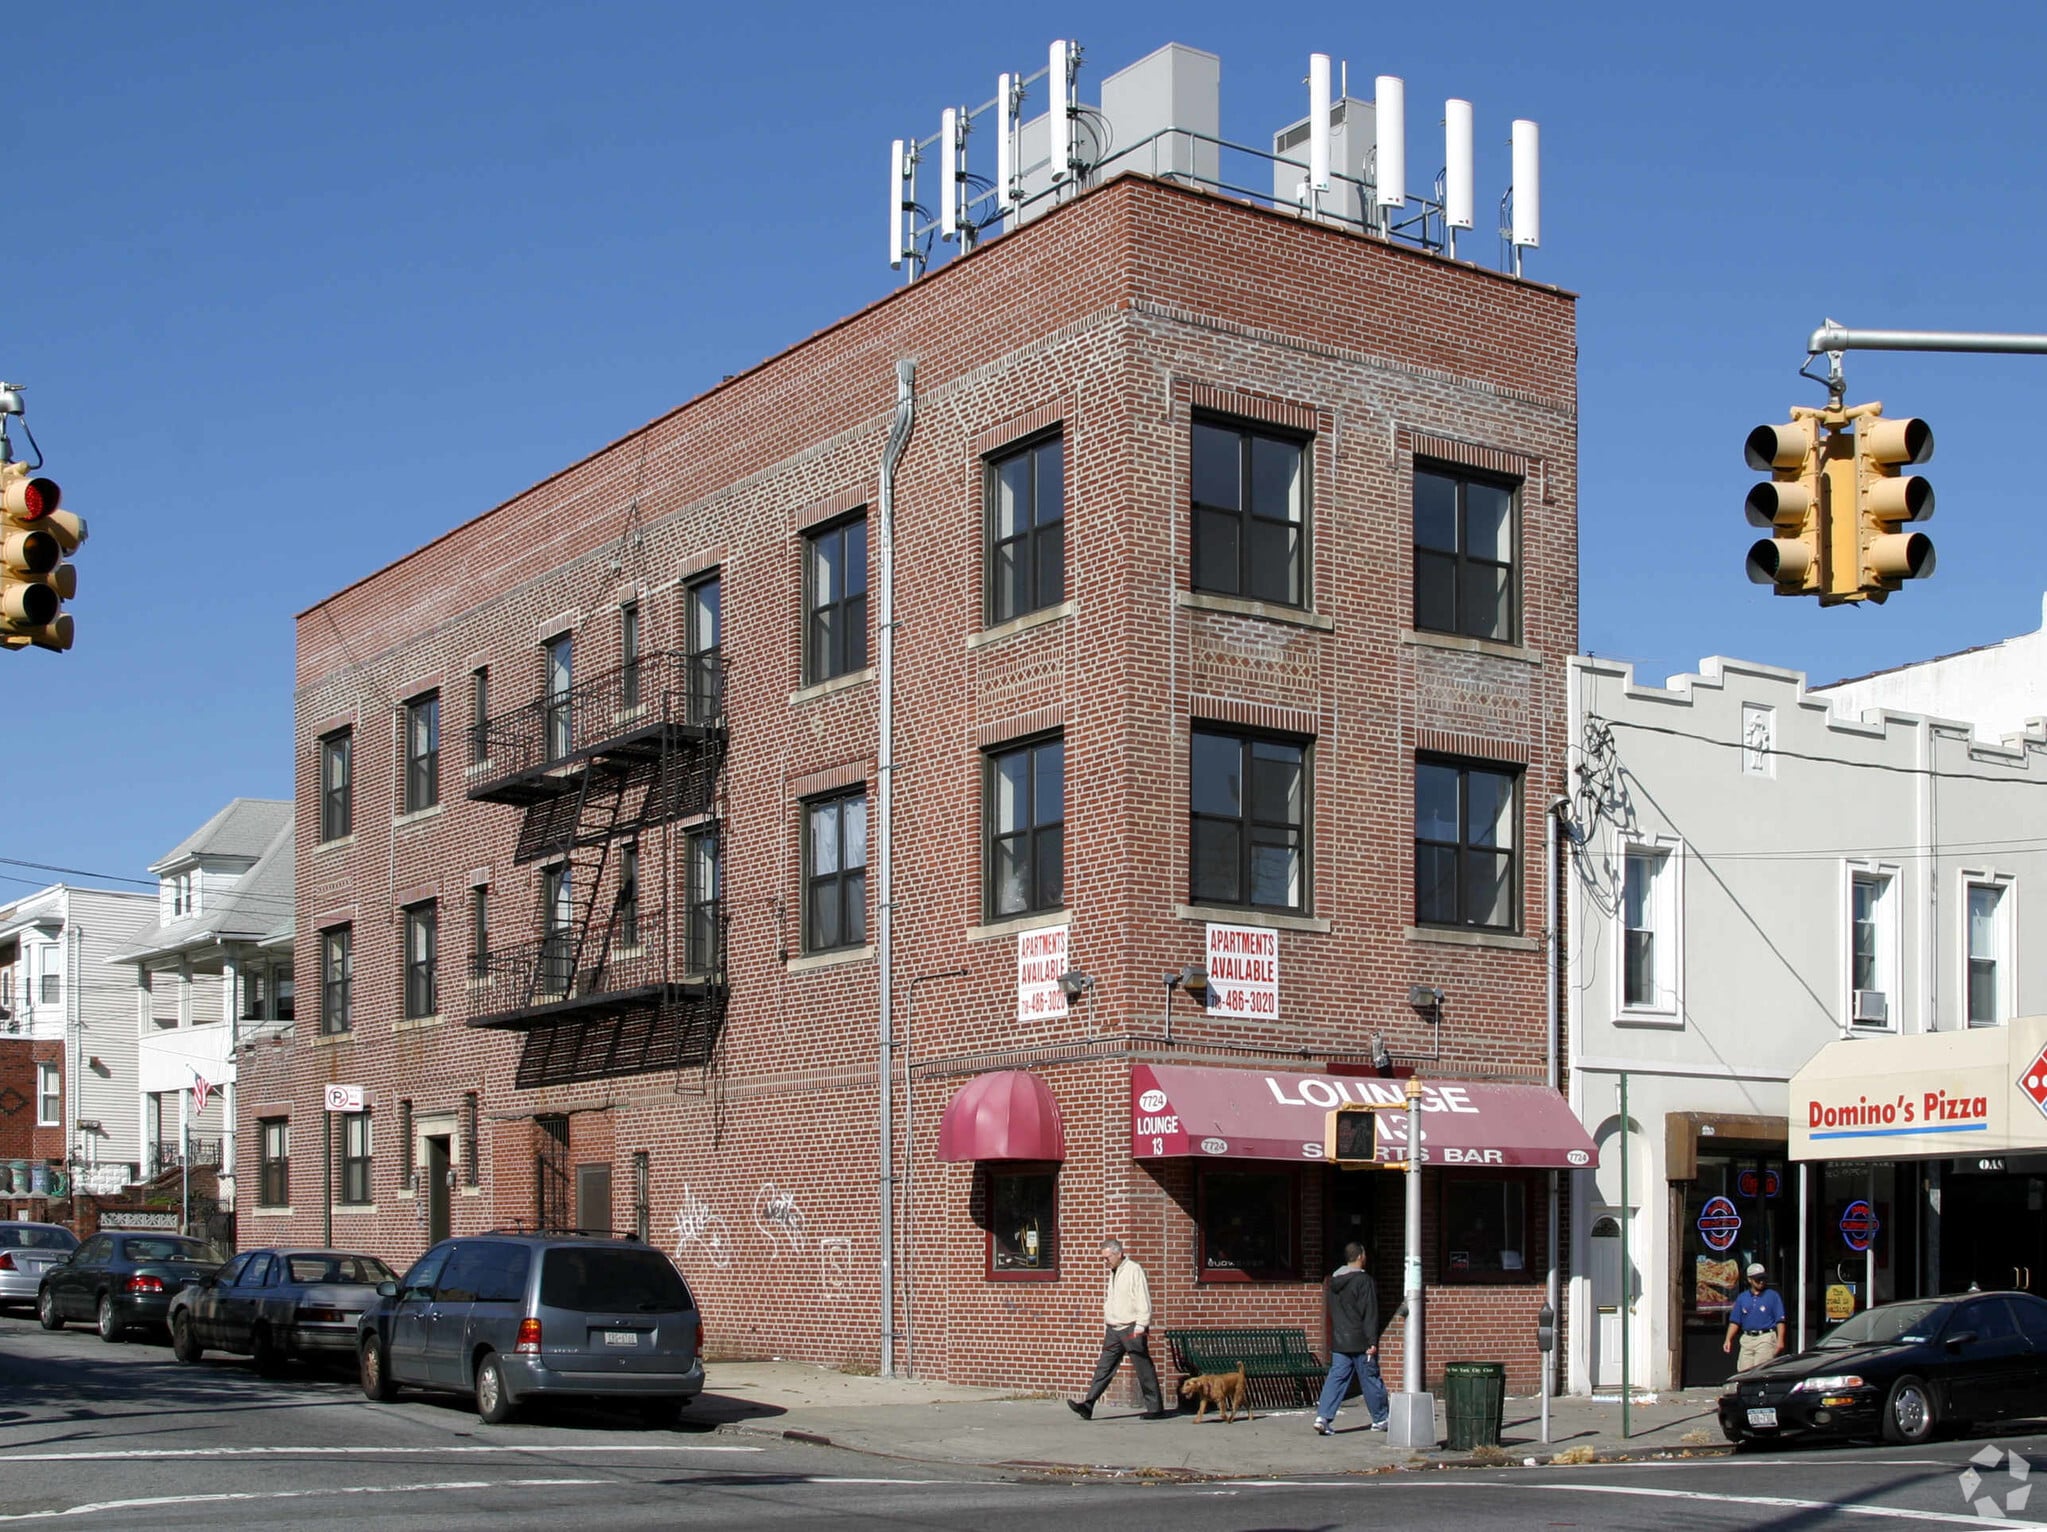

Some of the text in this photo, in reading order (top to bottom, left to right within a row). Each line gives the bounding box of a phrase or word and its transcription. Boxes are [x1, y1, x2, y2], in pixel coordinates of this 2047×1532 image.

[1021, 931, 1065, 958] APARTMENTS
[1211, 930, 1274, 956] APARTMENTS
[1021, 958, 1065, 985] AVAILABLE
[1211, 956, 1274, 982] AVAILABLE
[1142, 1095, 1165, 1108] 7724
[1265, 1077, 1479, 1114] LOUNGE
[1809, 1089, 1988, 1128] Domino's Pizza
[1137, 1115, 1178, 1135] LOUNGE
[1152, 1137, 1163, 1155] 13
[1203, 1140, 1226, 1152] 7724
[1444, 1148, 1503, 1164] BAR
[1569, 1152, 1588, 1162] 7724
